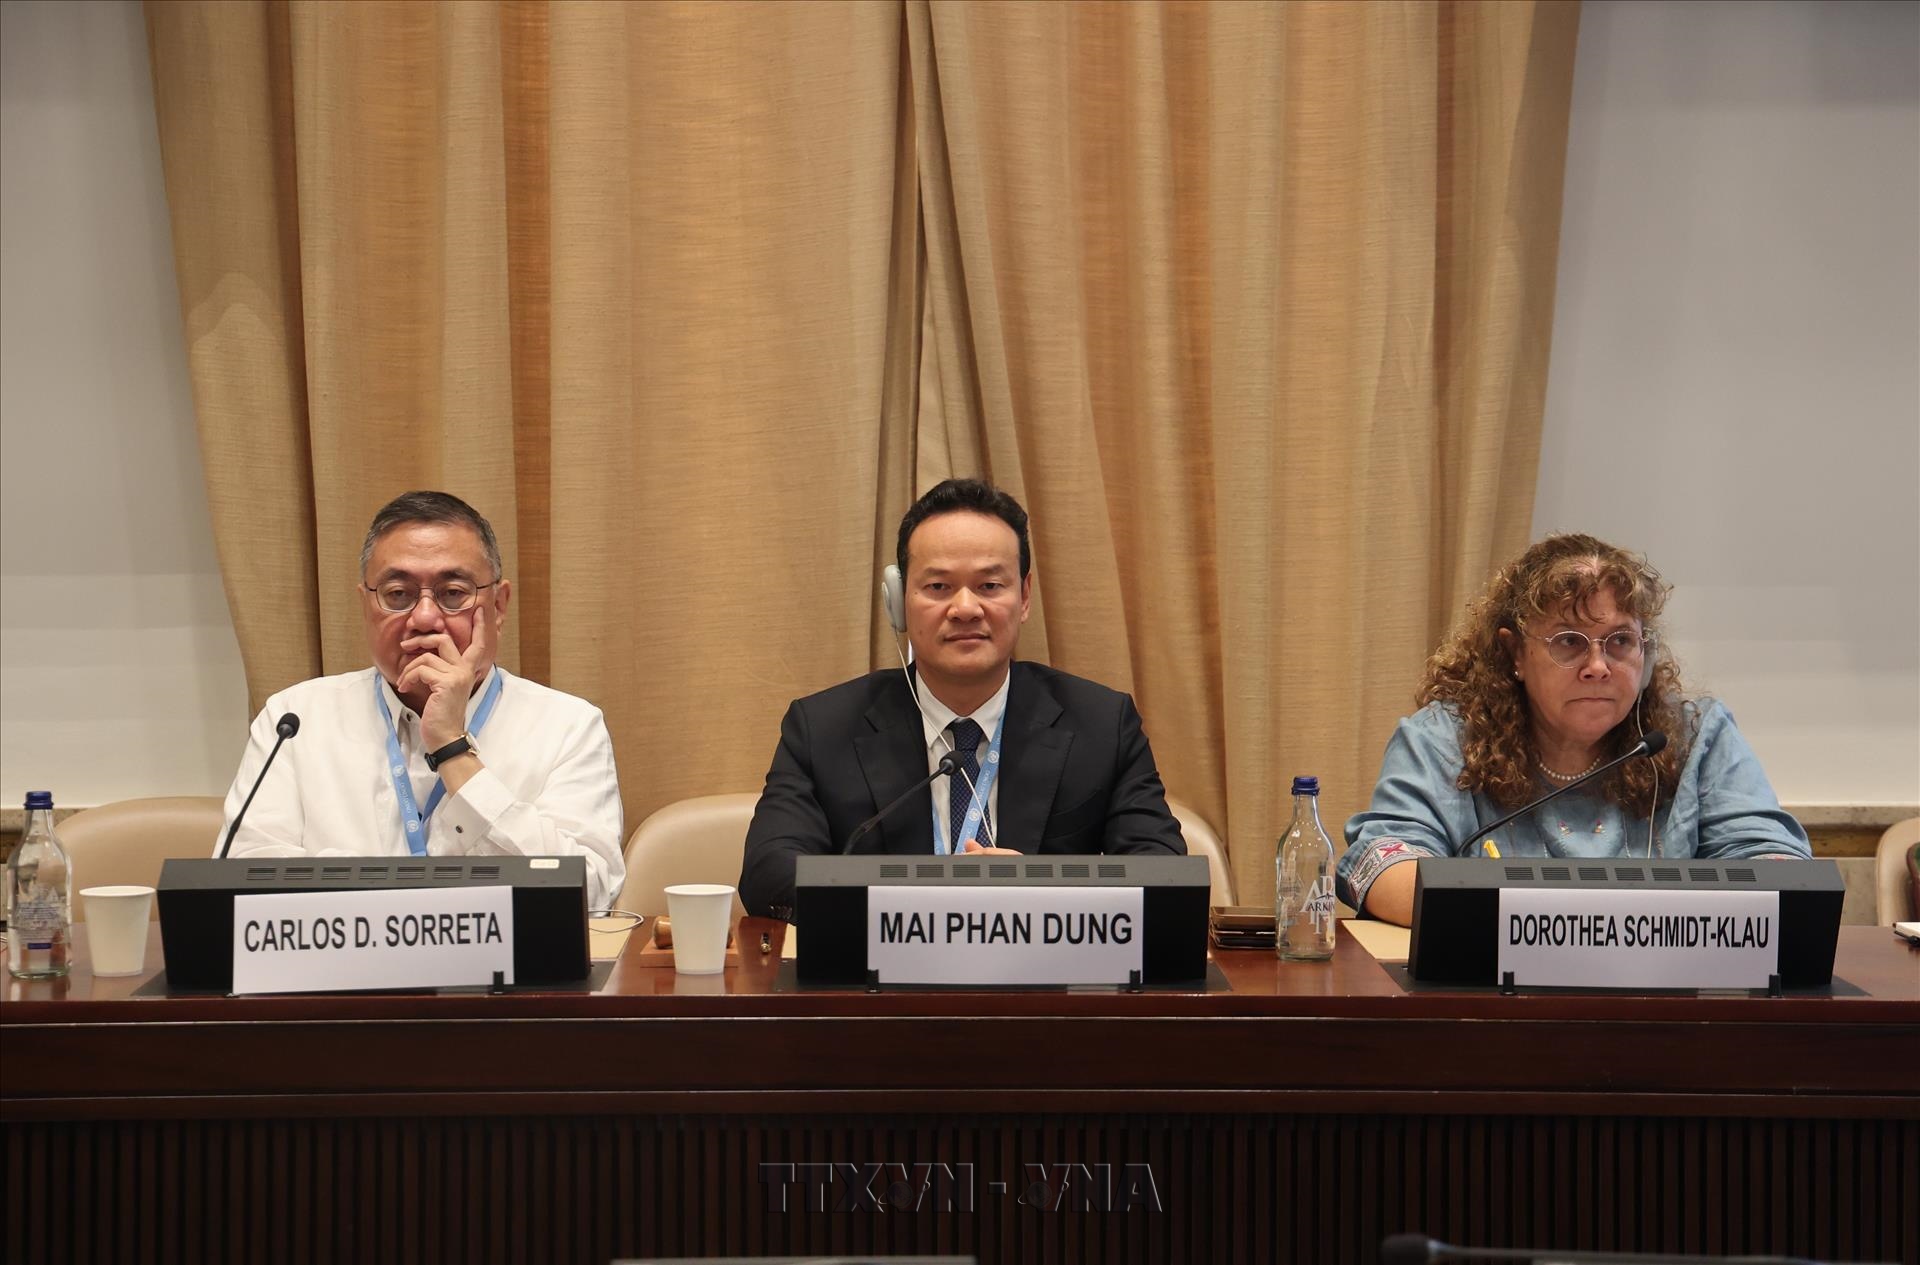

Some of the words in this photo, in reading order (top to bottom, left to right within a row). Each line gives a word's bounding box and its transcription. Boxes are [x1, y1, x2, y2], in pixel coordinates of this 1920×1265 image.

[244, 917, 346, 953] CARLOS
[355, 916, 377, 948] D.
[385, 912, 503, 948] SORRETA
[880, 912, 935, 944] MAI
[946, 912, 1031, 945] PHAN
[1043, 912, 1133, 945] DUNG
[1509, 913, 1619, 947] DOROTHEA
[1623, 914, 1770, 949] SCHMIDT-KLAU
